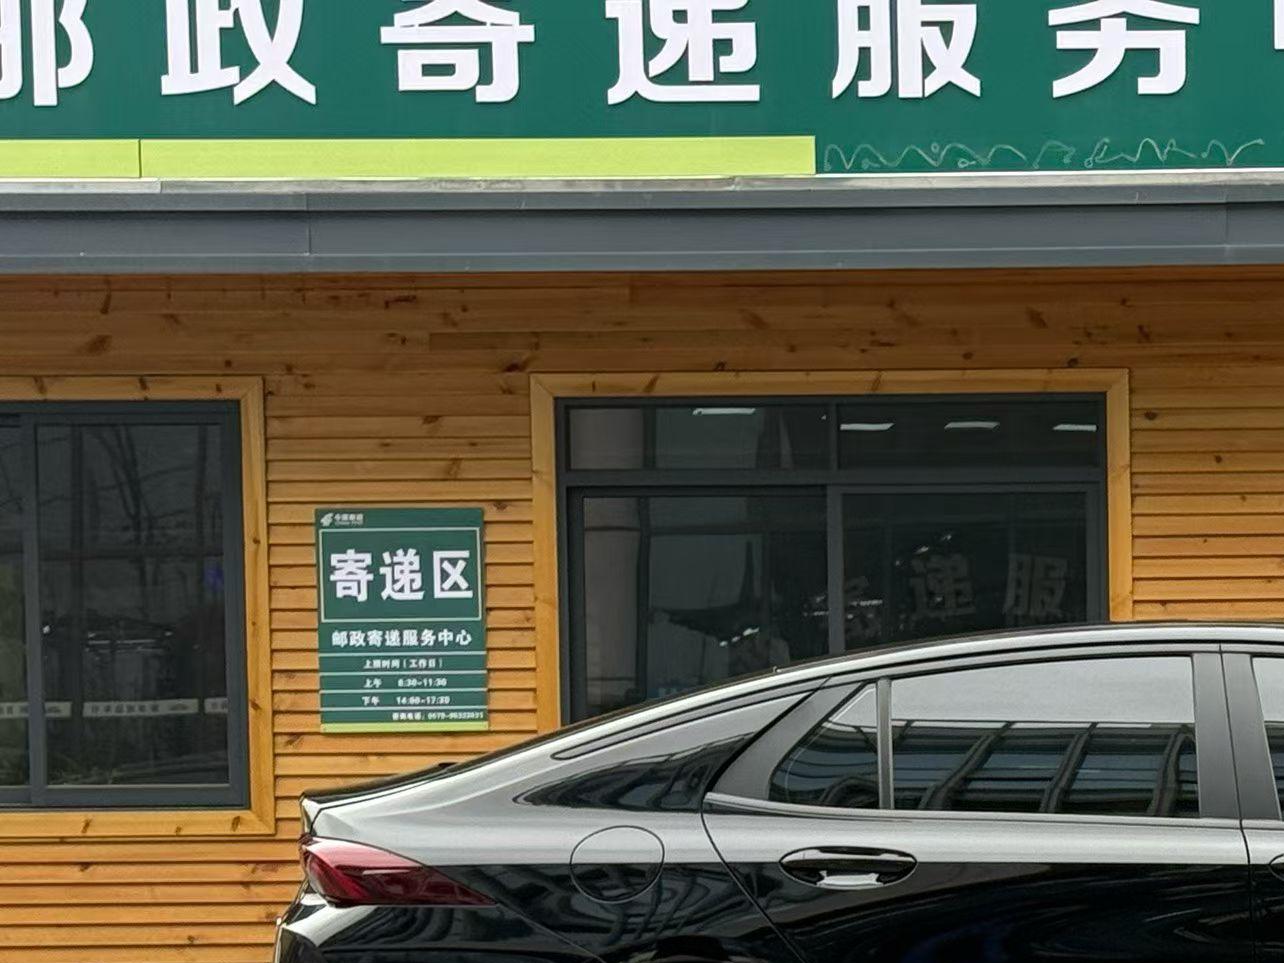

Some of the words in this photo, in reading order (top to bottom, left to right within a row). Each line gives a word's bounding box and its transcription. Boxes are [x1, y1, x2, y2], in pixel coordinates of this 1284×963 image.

[329, 548, 474, 602] 寄递区
[331, 628, 473, 648] 邮政寄递服务中心
[364, 678, 382, 688] 上午
[361, 696, 380, 706] 下午
